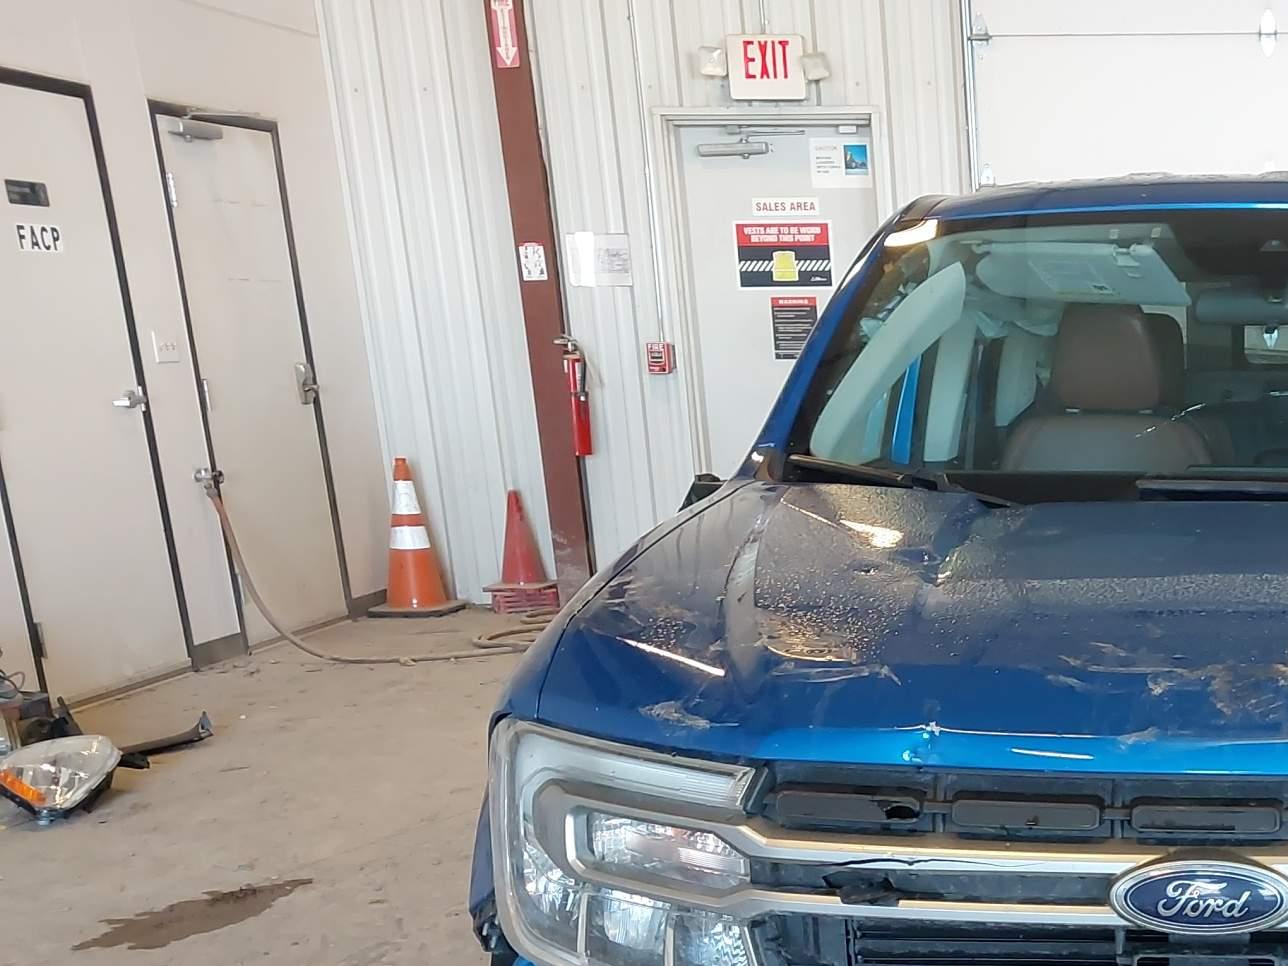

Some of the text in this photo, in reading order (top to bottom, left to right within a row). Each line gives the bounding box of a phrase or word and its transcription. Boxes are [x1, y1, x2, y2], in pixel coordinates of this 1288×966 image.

[742, 40, 789, 79] EXIT
[756, 201, 816, 212] SALES AREA
[16, 224, 60, 251] FACP
[743, 226, 764, 235] VESTS
[766, 226, 779, 235] ARE
[780, 226, 789, 235] TO
[790, 226, 799, 235] BE
[1157, 879, 1252, 918] Ford
